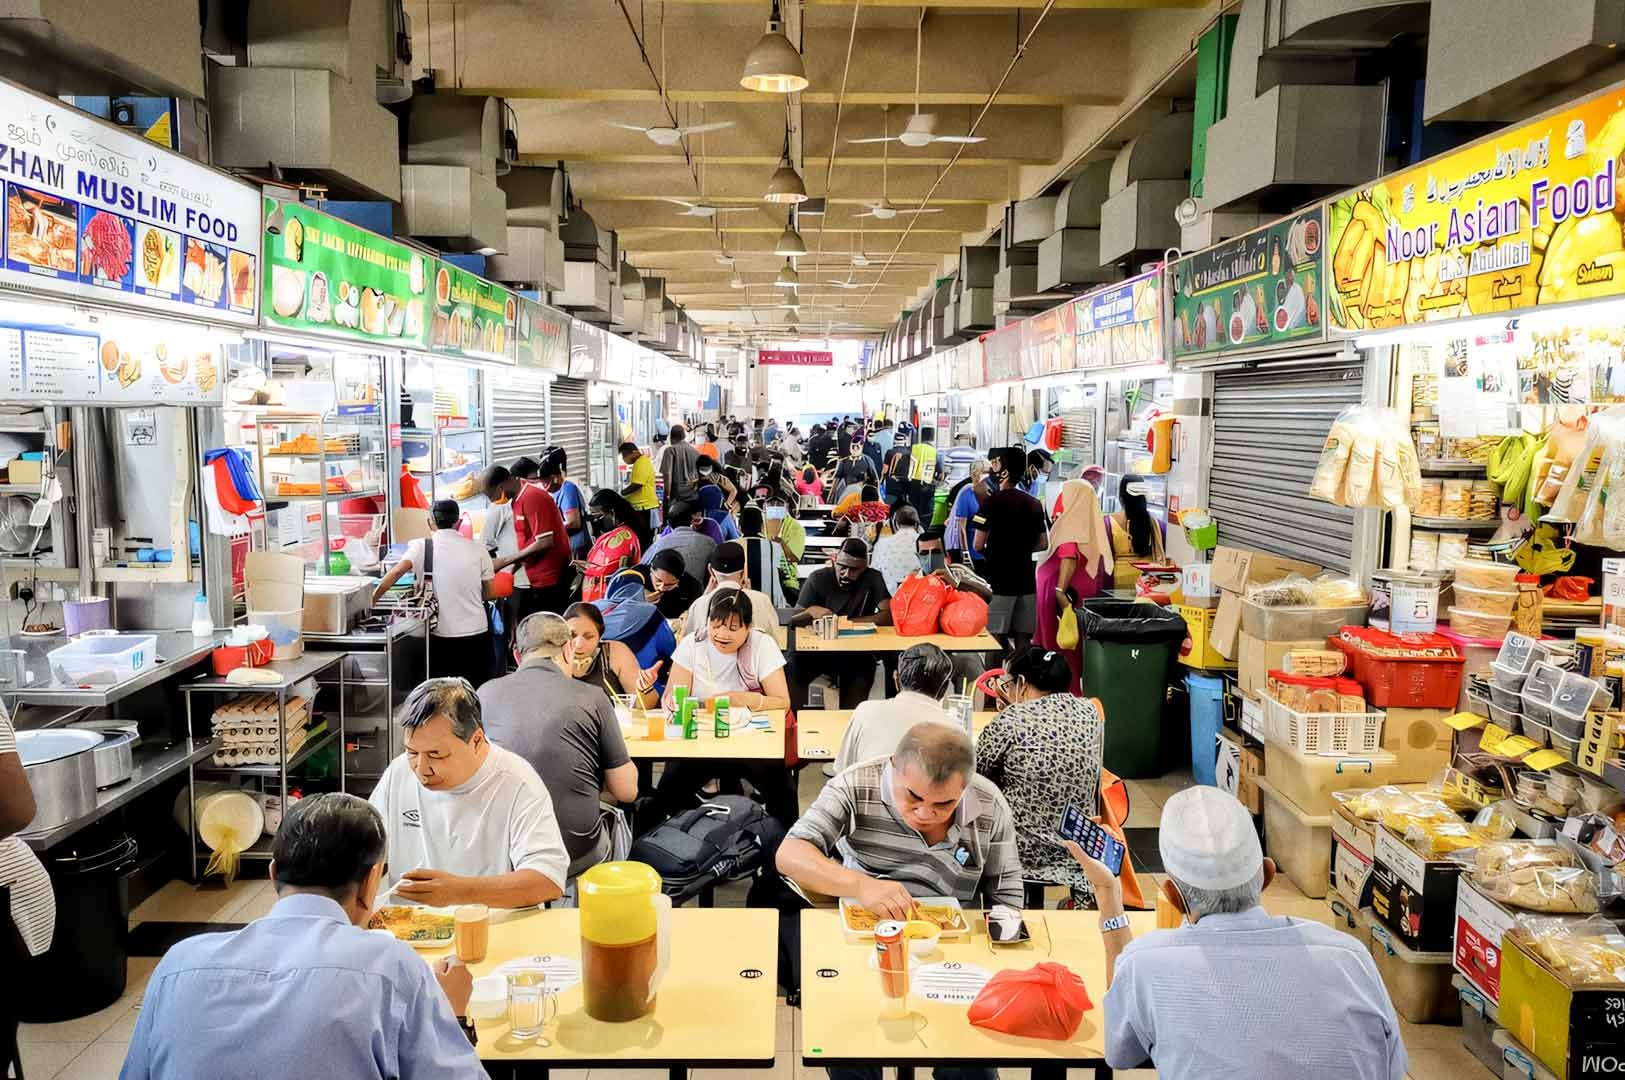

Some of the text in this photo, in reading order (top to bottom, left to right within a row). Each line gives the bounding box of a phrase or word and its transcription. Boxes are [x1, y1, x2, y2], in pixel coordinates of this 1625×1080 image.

[77, 170, 177, 225] MUSLIM
[186, 208, 238, 242] FOOD
[1387, 224, 1438, 262] Noor
[1448, 200, 1519, 248] Asian
[1532, 160, 1613, 227] Food
